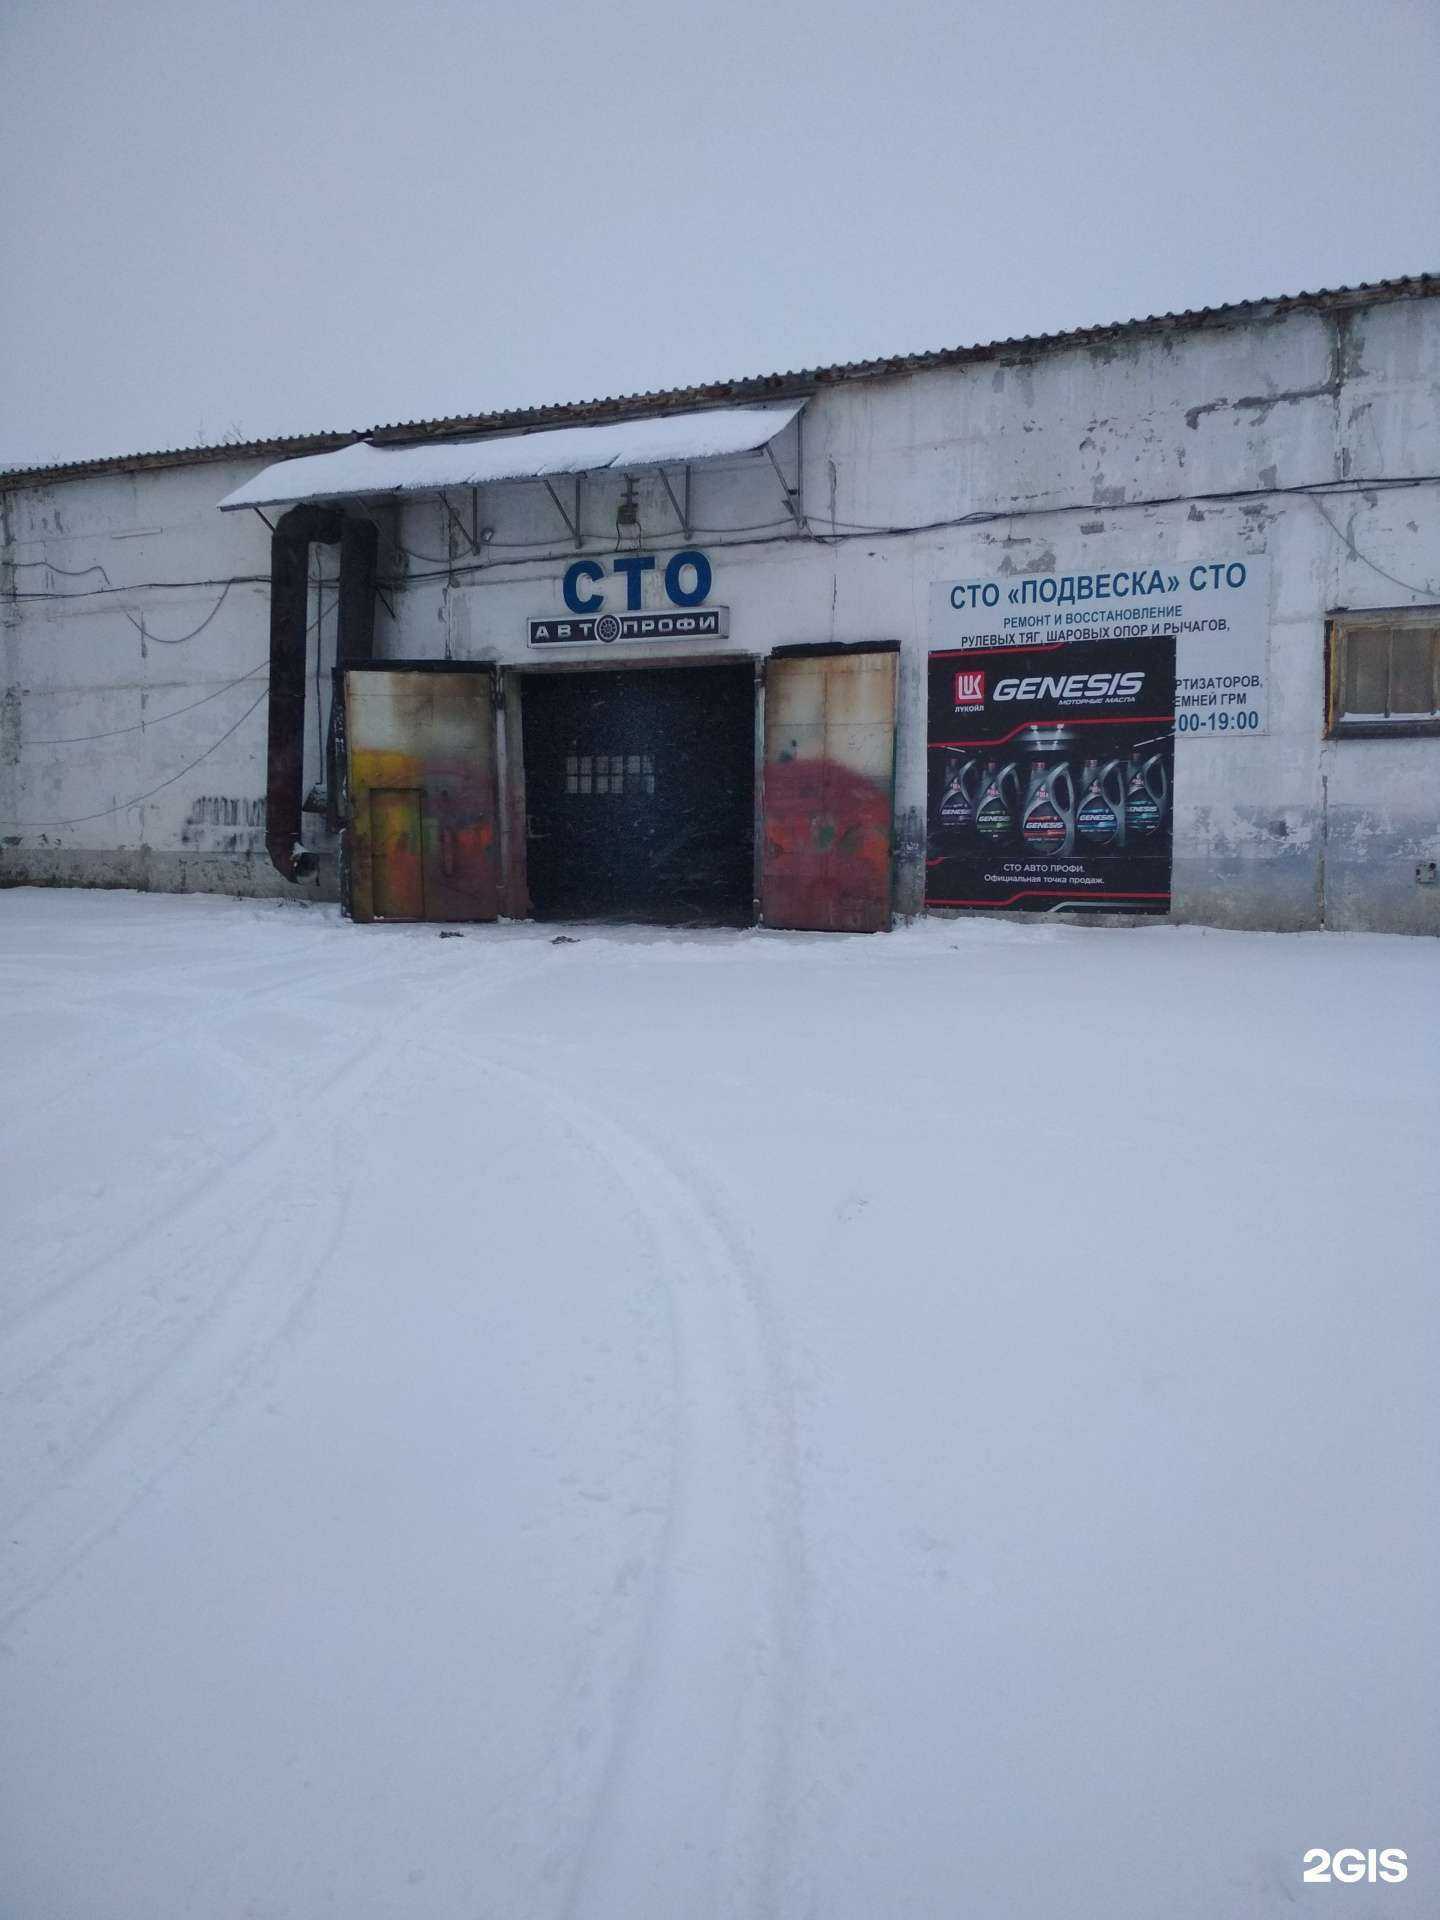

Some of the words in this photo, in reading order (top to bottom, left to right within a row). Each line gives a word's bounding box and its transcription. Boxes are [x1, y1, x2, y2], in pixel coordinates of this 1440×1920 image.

[562, 550, 712, 615] СТО
[950, 583, 1000, 609] СТО
[1008, 569, 1180, 606] «ПОДВЕСКА»
[1189, 562, 1247, 591] СТО
[1003, 614, 1051, 629] РЕМОНТ
[1054, 613, 1062, 625] И
[1065, 605, 1183, 624] ВОССТАНОВЛЕНИЕ
[961, 633, 1016, 647] РУЛЕВЫХ
[1018, 631, 1044, 646] ТЯГ,
[1046, 626, 1110, 642] ШАРОВЫХ
[1113, 623, 1148, 638] ОПОР
[1151, 622, 1160, 635] И
[1163, 618, 1231, 635] РЫЧАГОВ,
[992, 671, 1145, 702] GENESIS
[954, 704, 985, 713] ЛУКОЙЛ
[1220, 693, 1247, 705] ГРМ
[1174, 710, 1258, 732] 00-19:00
[984, 873, 1041, 883] Официальная
[1003, 863, 1022, 872] СТО
[1023, 863, 1048, 872] АВТО
[1050, 864, 1085, 873] ПРОФИ.
